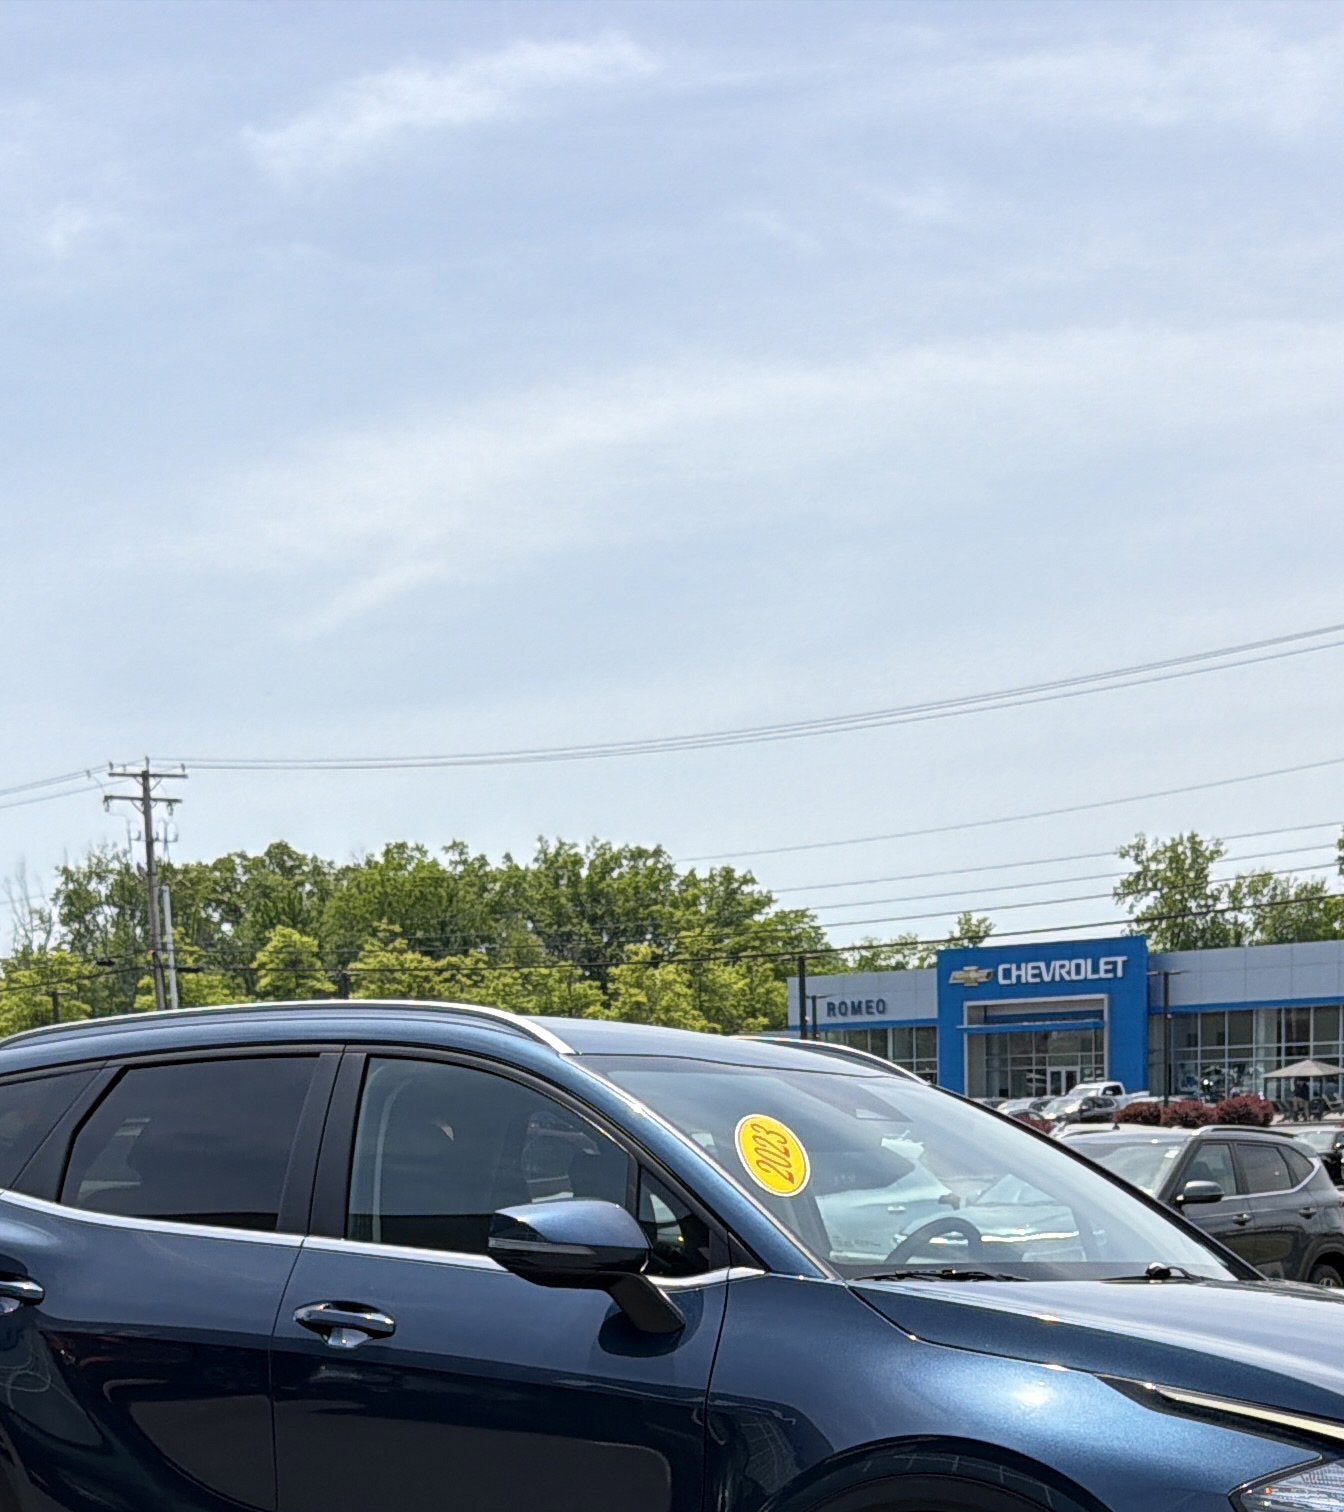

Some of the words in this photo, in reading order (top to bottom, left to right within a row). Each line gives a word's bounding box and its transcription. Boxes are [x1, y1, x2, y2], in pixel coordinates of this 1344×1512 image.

[997, 956, 1128, 985] CHEVROLET
[826, 999, 886, 1017] ROMEO
[750, 1123, 795, 1184] 2023
